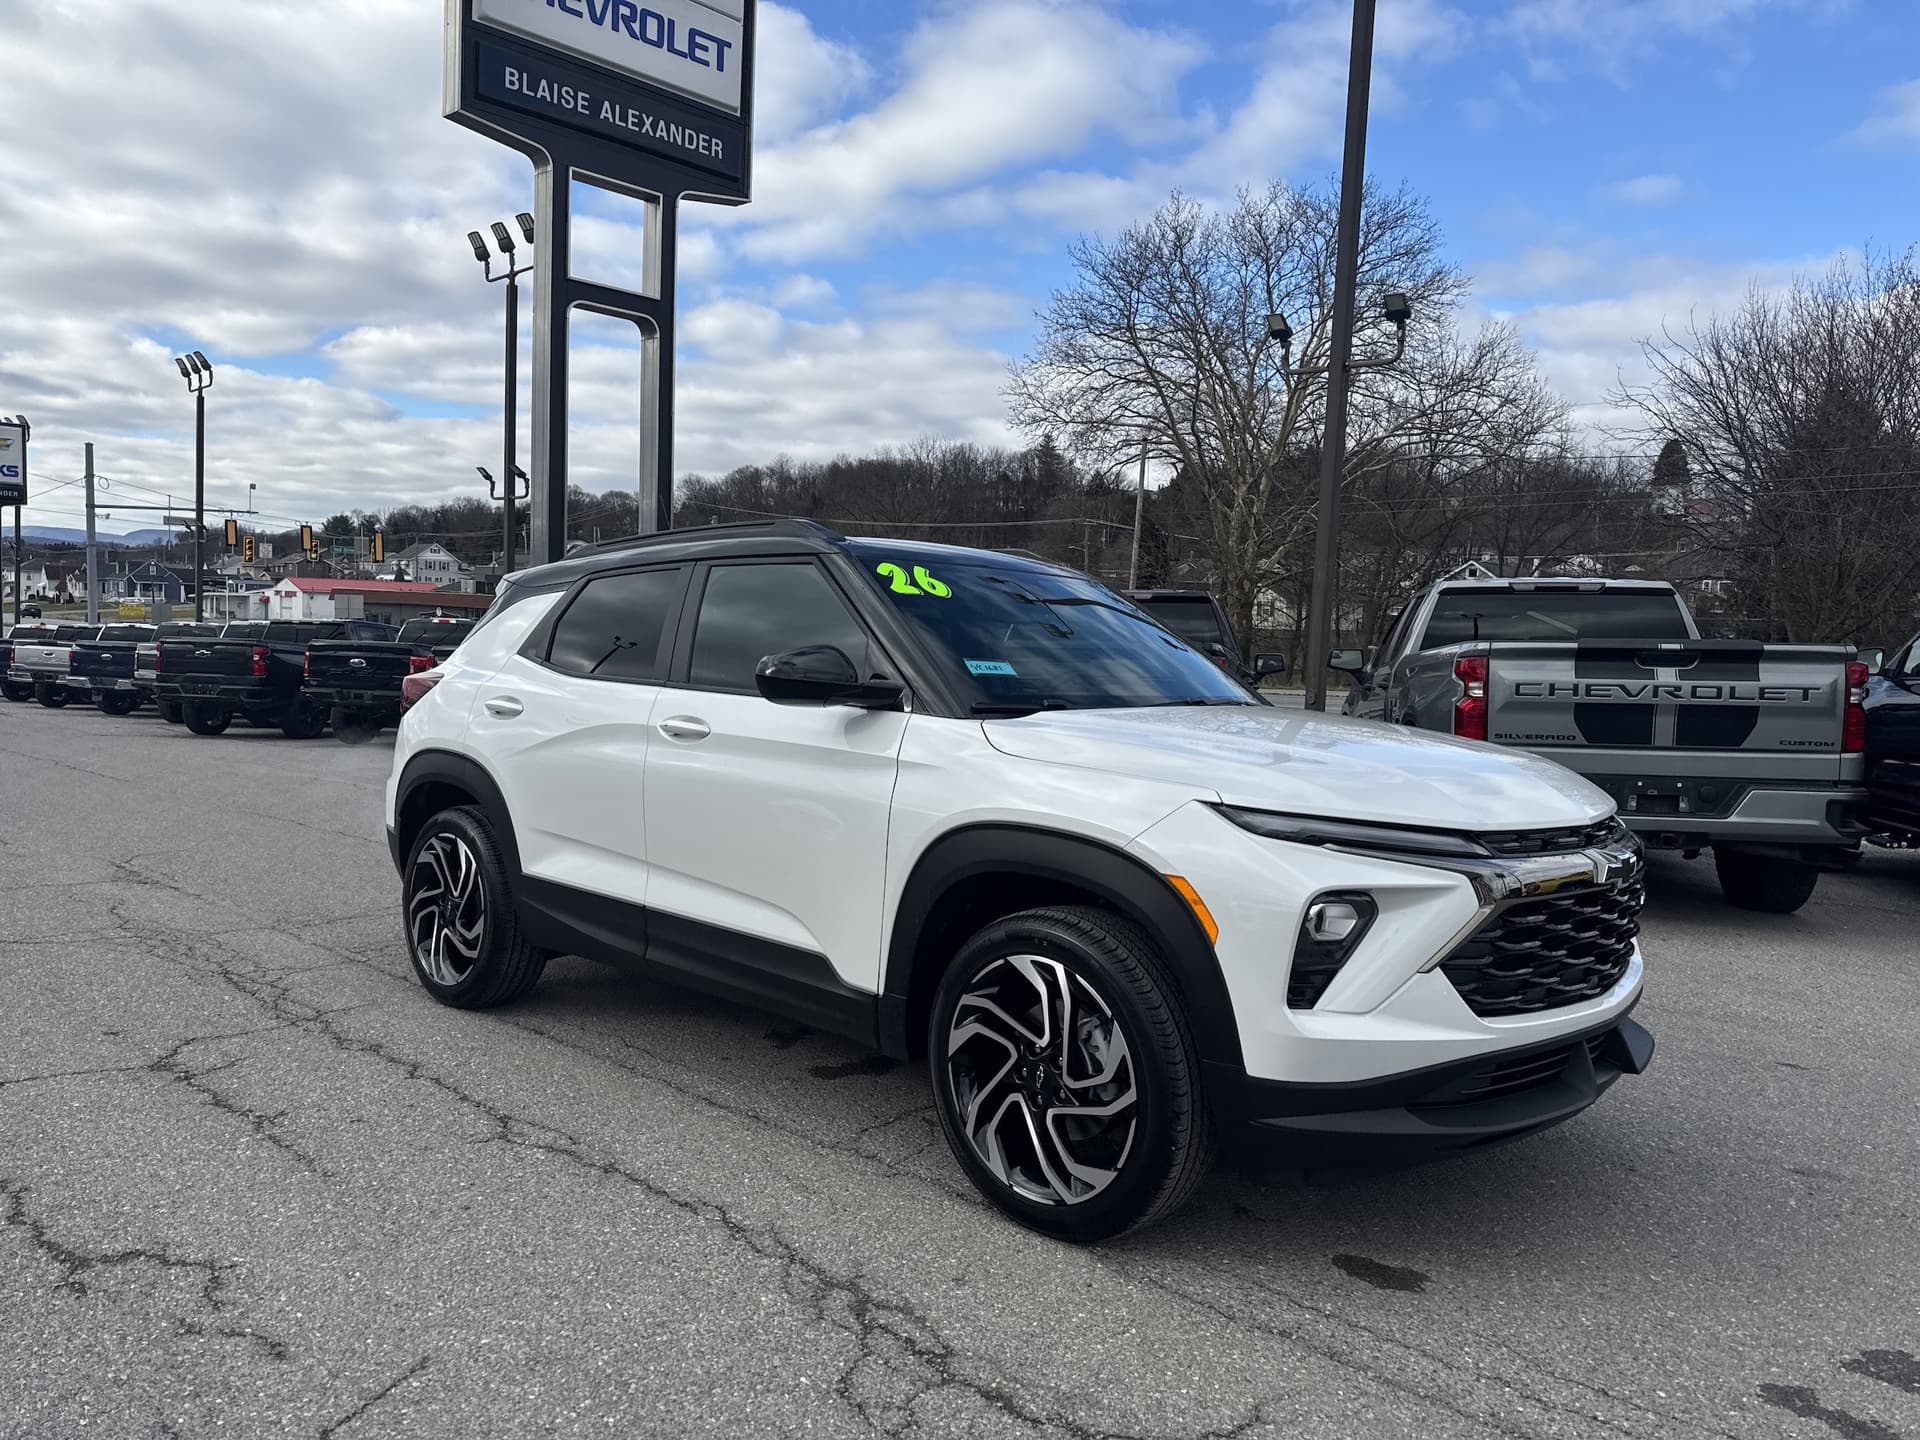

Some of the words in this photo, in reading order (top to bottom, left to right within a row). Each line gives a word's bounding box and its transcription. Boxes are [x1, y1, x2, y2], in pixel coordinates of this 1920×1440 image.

[504, 66, 590, 115] BLAISE
[599, 100, 723, 160] ALEXANDER
[876, 562, 953, 599] 26
[1514, 682, 1822, 702] CHEVROLET
[1494, 732, 1577, 741] SILVERADO
[1779, 738, 1836, 748] CUSTOM
